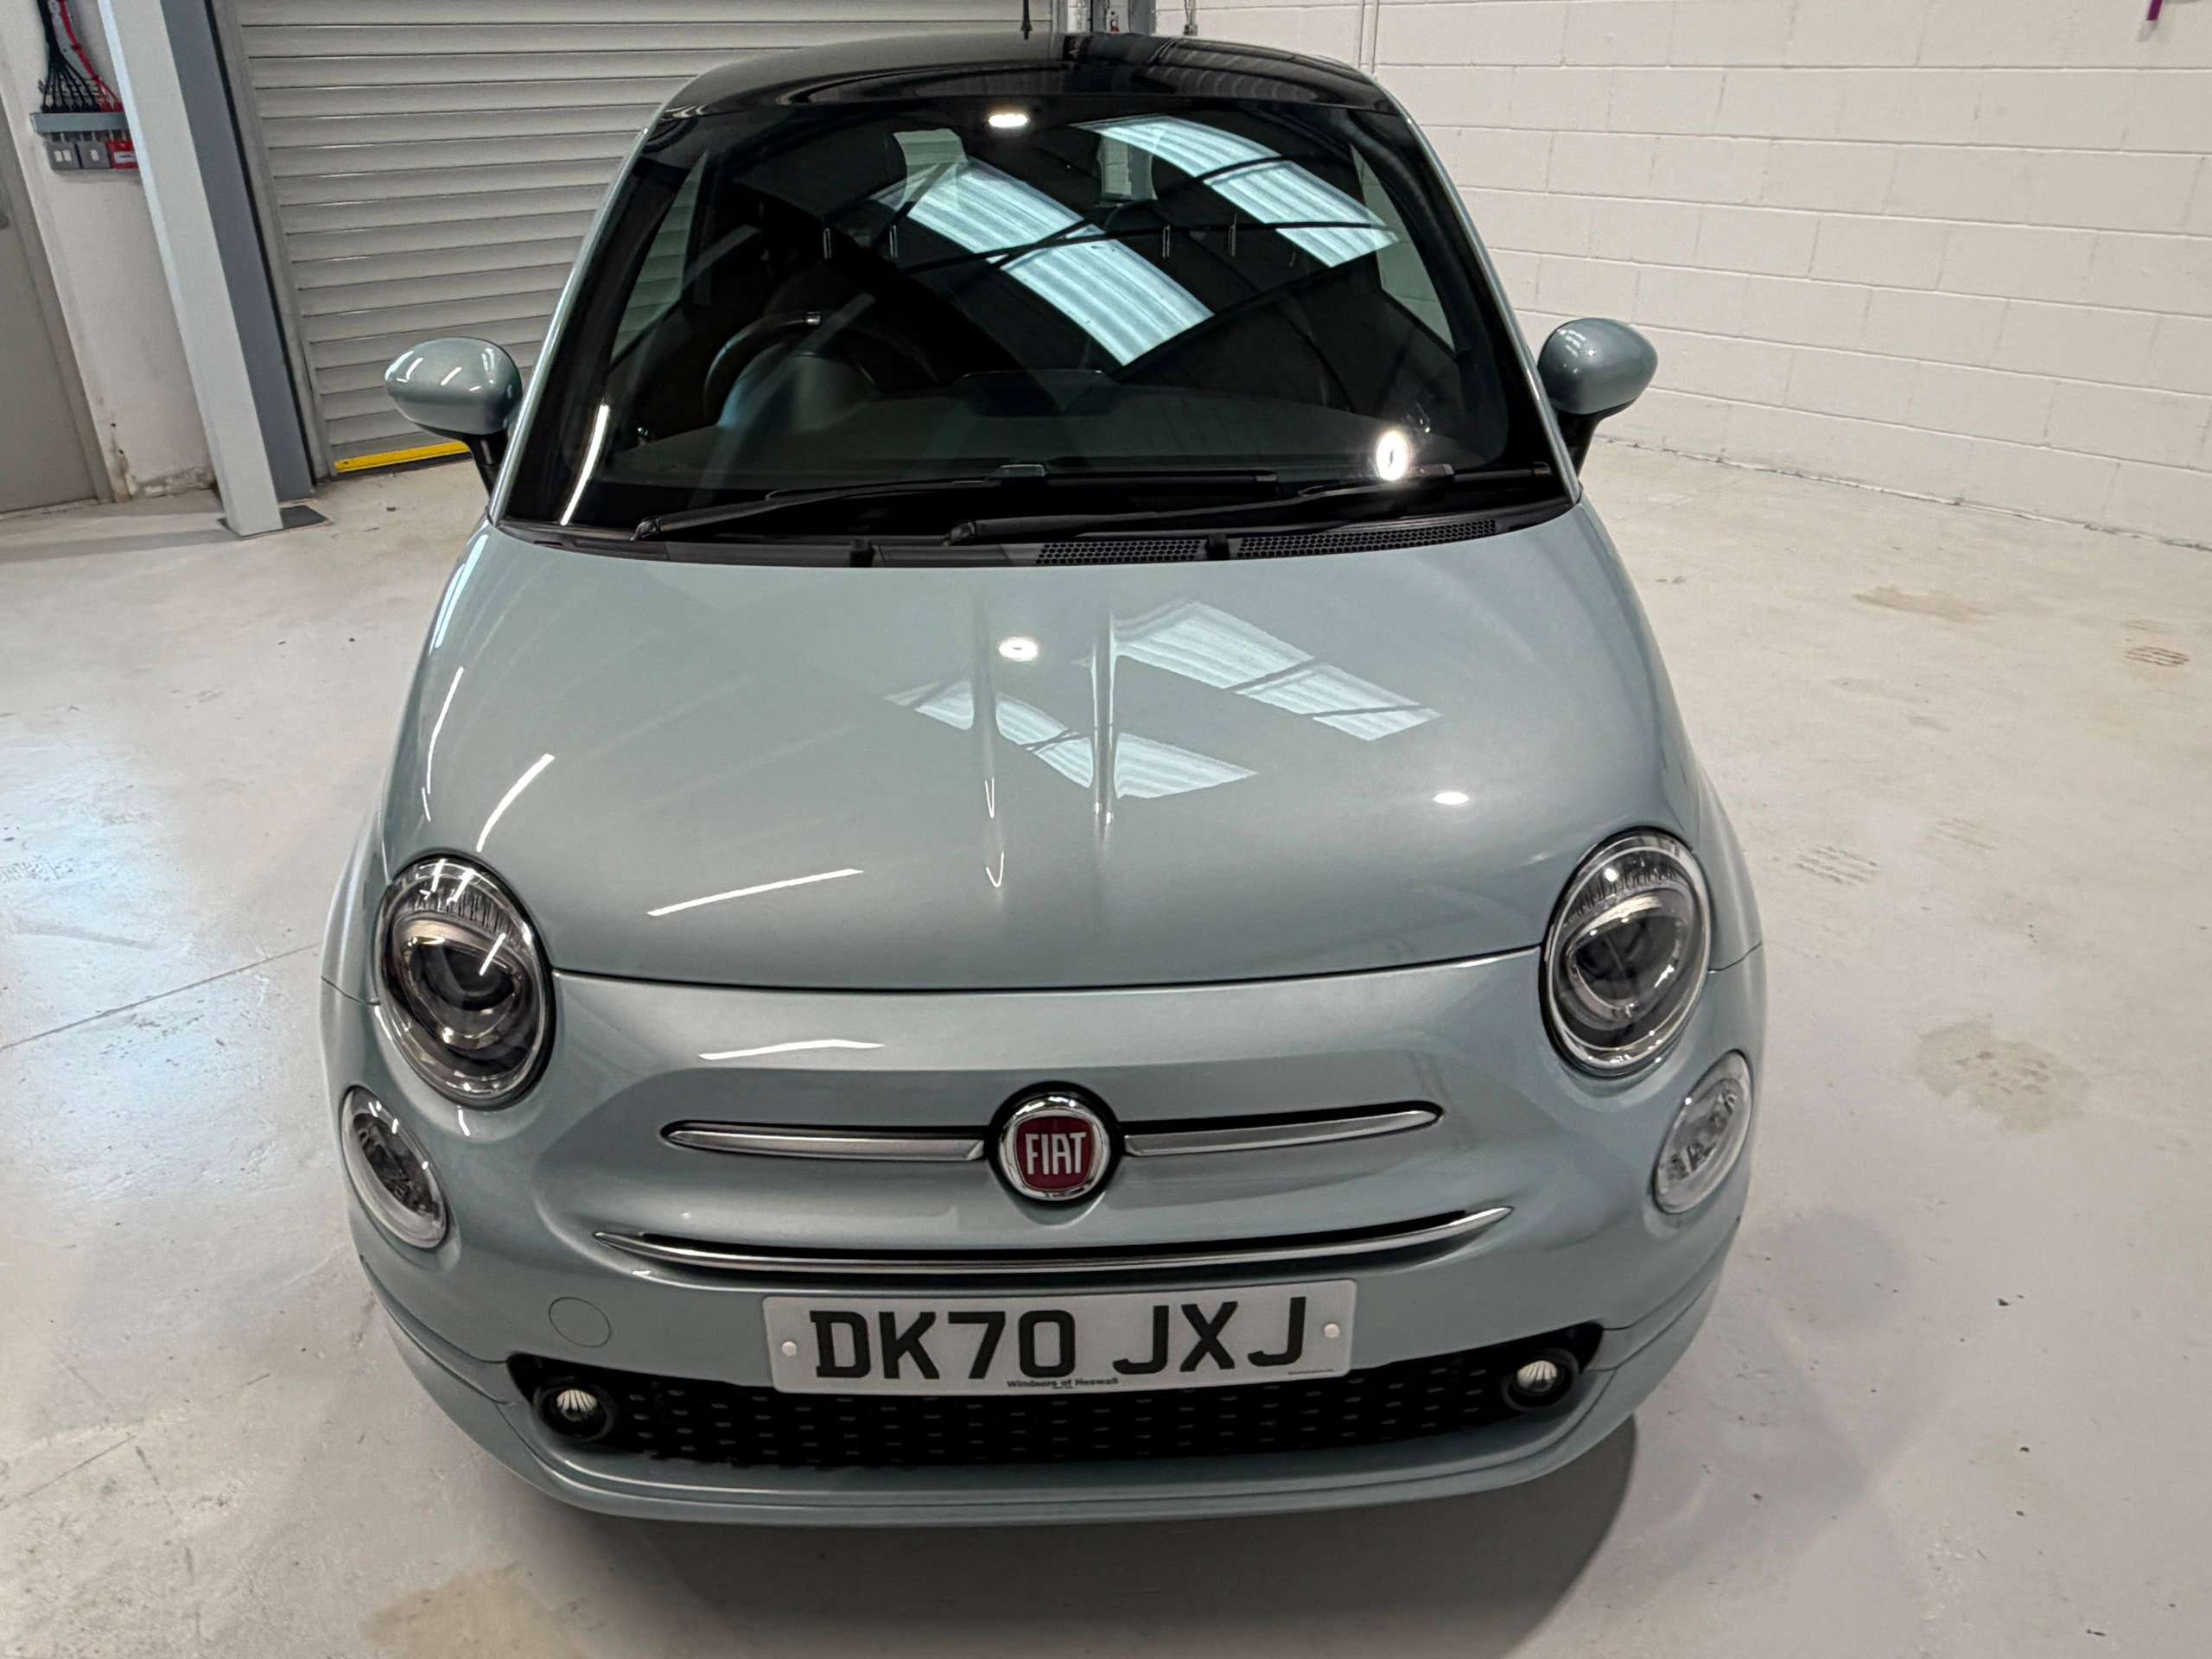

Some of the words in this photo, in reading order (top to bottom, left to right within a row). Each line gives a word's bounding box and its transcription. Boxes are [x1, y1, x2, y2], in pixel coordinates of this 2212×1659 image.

[1025, 1132, 1087, 1175] FIAT
[809, 1309, 1077, 1380] DK70
[1112, 1296, 1306, 1376] JXJ
